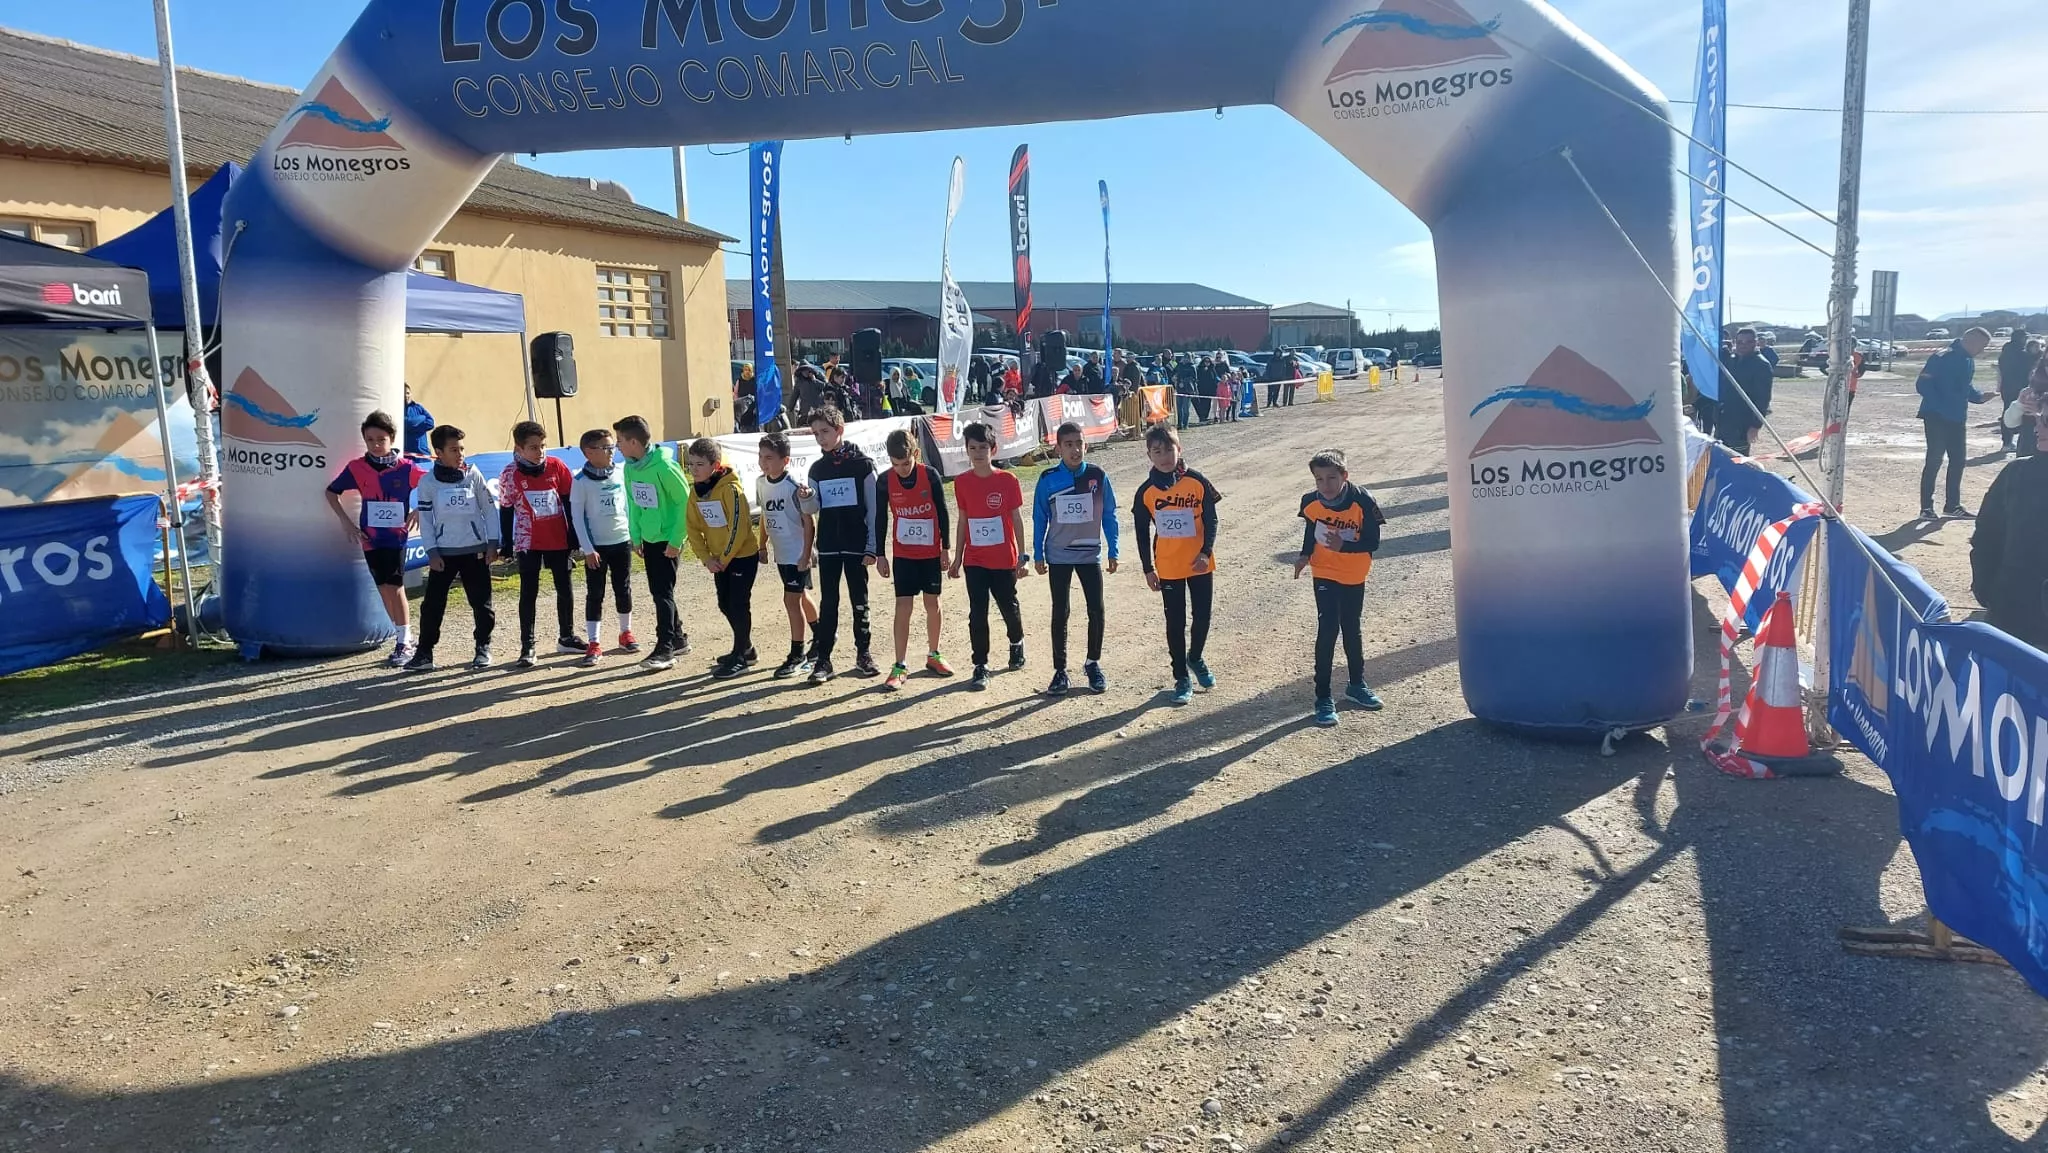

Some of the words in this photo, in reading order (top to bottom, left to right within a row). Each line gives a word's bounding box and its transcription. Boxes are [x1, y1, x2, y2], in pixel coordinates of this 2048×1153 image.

[453, 64, 663, 118] CONSEJO
[678, 37, 965, 103] COMARCAL
[1328, 89, 1367, 109] Los
[1375, 67, 1513, 104] Monegros
[1333, 106, 1380, 120] CONSEJO
[1383, 96, 1450, 115] COMARCAL
[273, 154, 300, 170] Los
[306, 153, 411, 175] Monegros
[273, 171, 310, 181] CONSEJO
[312, 171, 366, 182] COMARCAL
[760, 150, 774, 299] Monegros
[72, 282, 122, 306] barri
[73, 382, 157, 401] COMARCA
[228, 445, 327, 471] Monegros
[1470, 463, 1510, 485] Los
[1521, 454, 1666, 482] Monegros
[830, 486, 844, 497] 44
[1471, 484, 1525, 499] CONSEJO
[1529, 479, 1611, 495] COMARCAL
[450, 495, 465, 506] 65
[534, 497, 548, 508] 55
[1067, 502, 1083, 514] 59
[378, 509, 393, 520] 22
[1166, 518, 1182, 530] 26
[908, 526, 923, 536] 63
